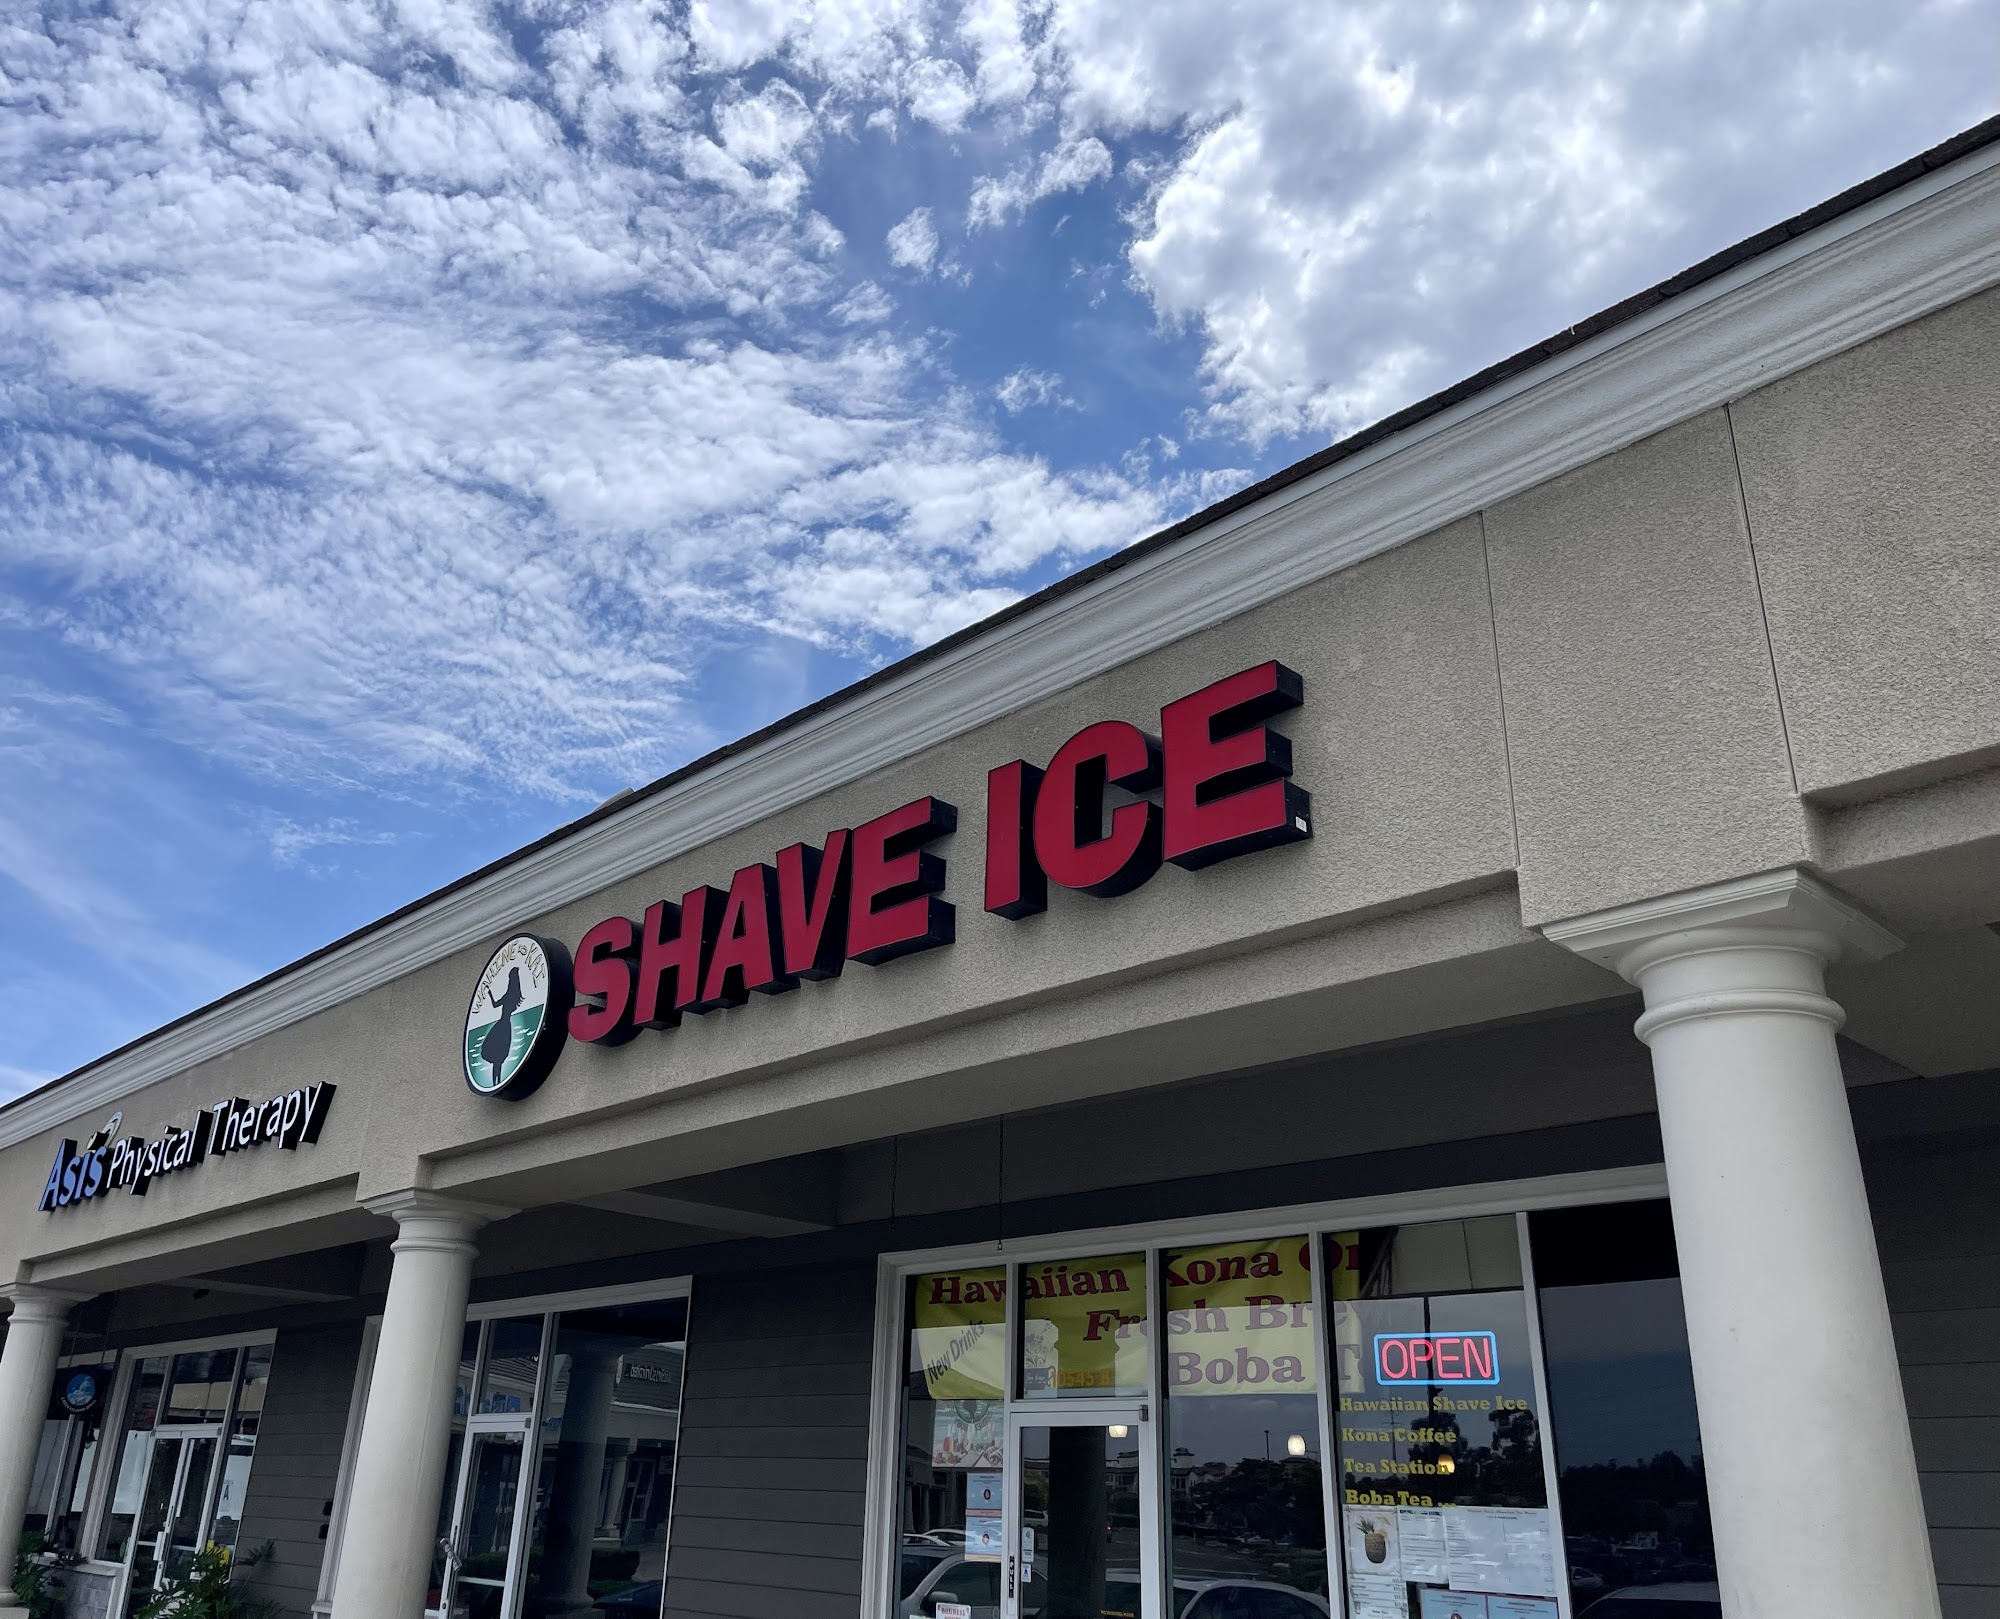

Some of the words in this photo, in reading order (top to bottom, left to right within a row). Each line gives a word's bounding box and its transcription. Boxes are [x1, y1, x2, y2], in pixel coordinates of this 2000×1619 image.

[568, 796, 957, 1045] SHAVE
[985, 660, 1312, 918] ICE
[472, 939, 519, 1013] WAHINE
[525, 943, 547, 988] KAI
[107, 1110, 213, 1196] Physical
[208, 1081, 337, 1156] Therapy
[929, 1266, 1131, 1305] Hawaiian
[1245, 1294, 1360, 1331] Bre
[927, 1350, 952, 1385] New
[949, 1320, 984, 1362] Drinks
[1169, 1346, 1306, 1386] Boba
[1380, 1337, 1493, 1380] OPEN
[1340, 1397, 1428, 1412] Hawaiian
[1433, 1396, 1491, 1412] Shave
[1495, 1395, 1528, 1411] Ice
[1342, 1428, 1390, 1443] Kona
[1394, 1427, 1457, 1443] Coffee
[1344, 1458, 1376, 1474] Tea
[1380, 1458, 1452, 1476] Station
[1345, 1489, 1395, 1505] Boba
[1397, 1490, 1434, 1507] Tea
